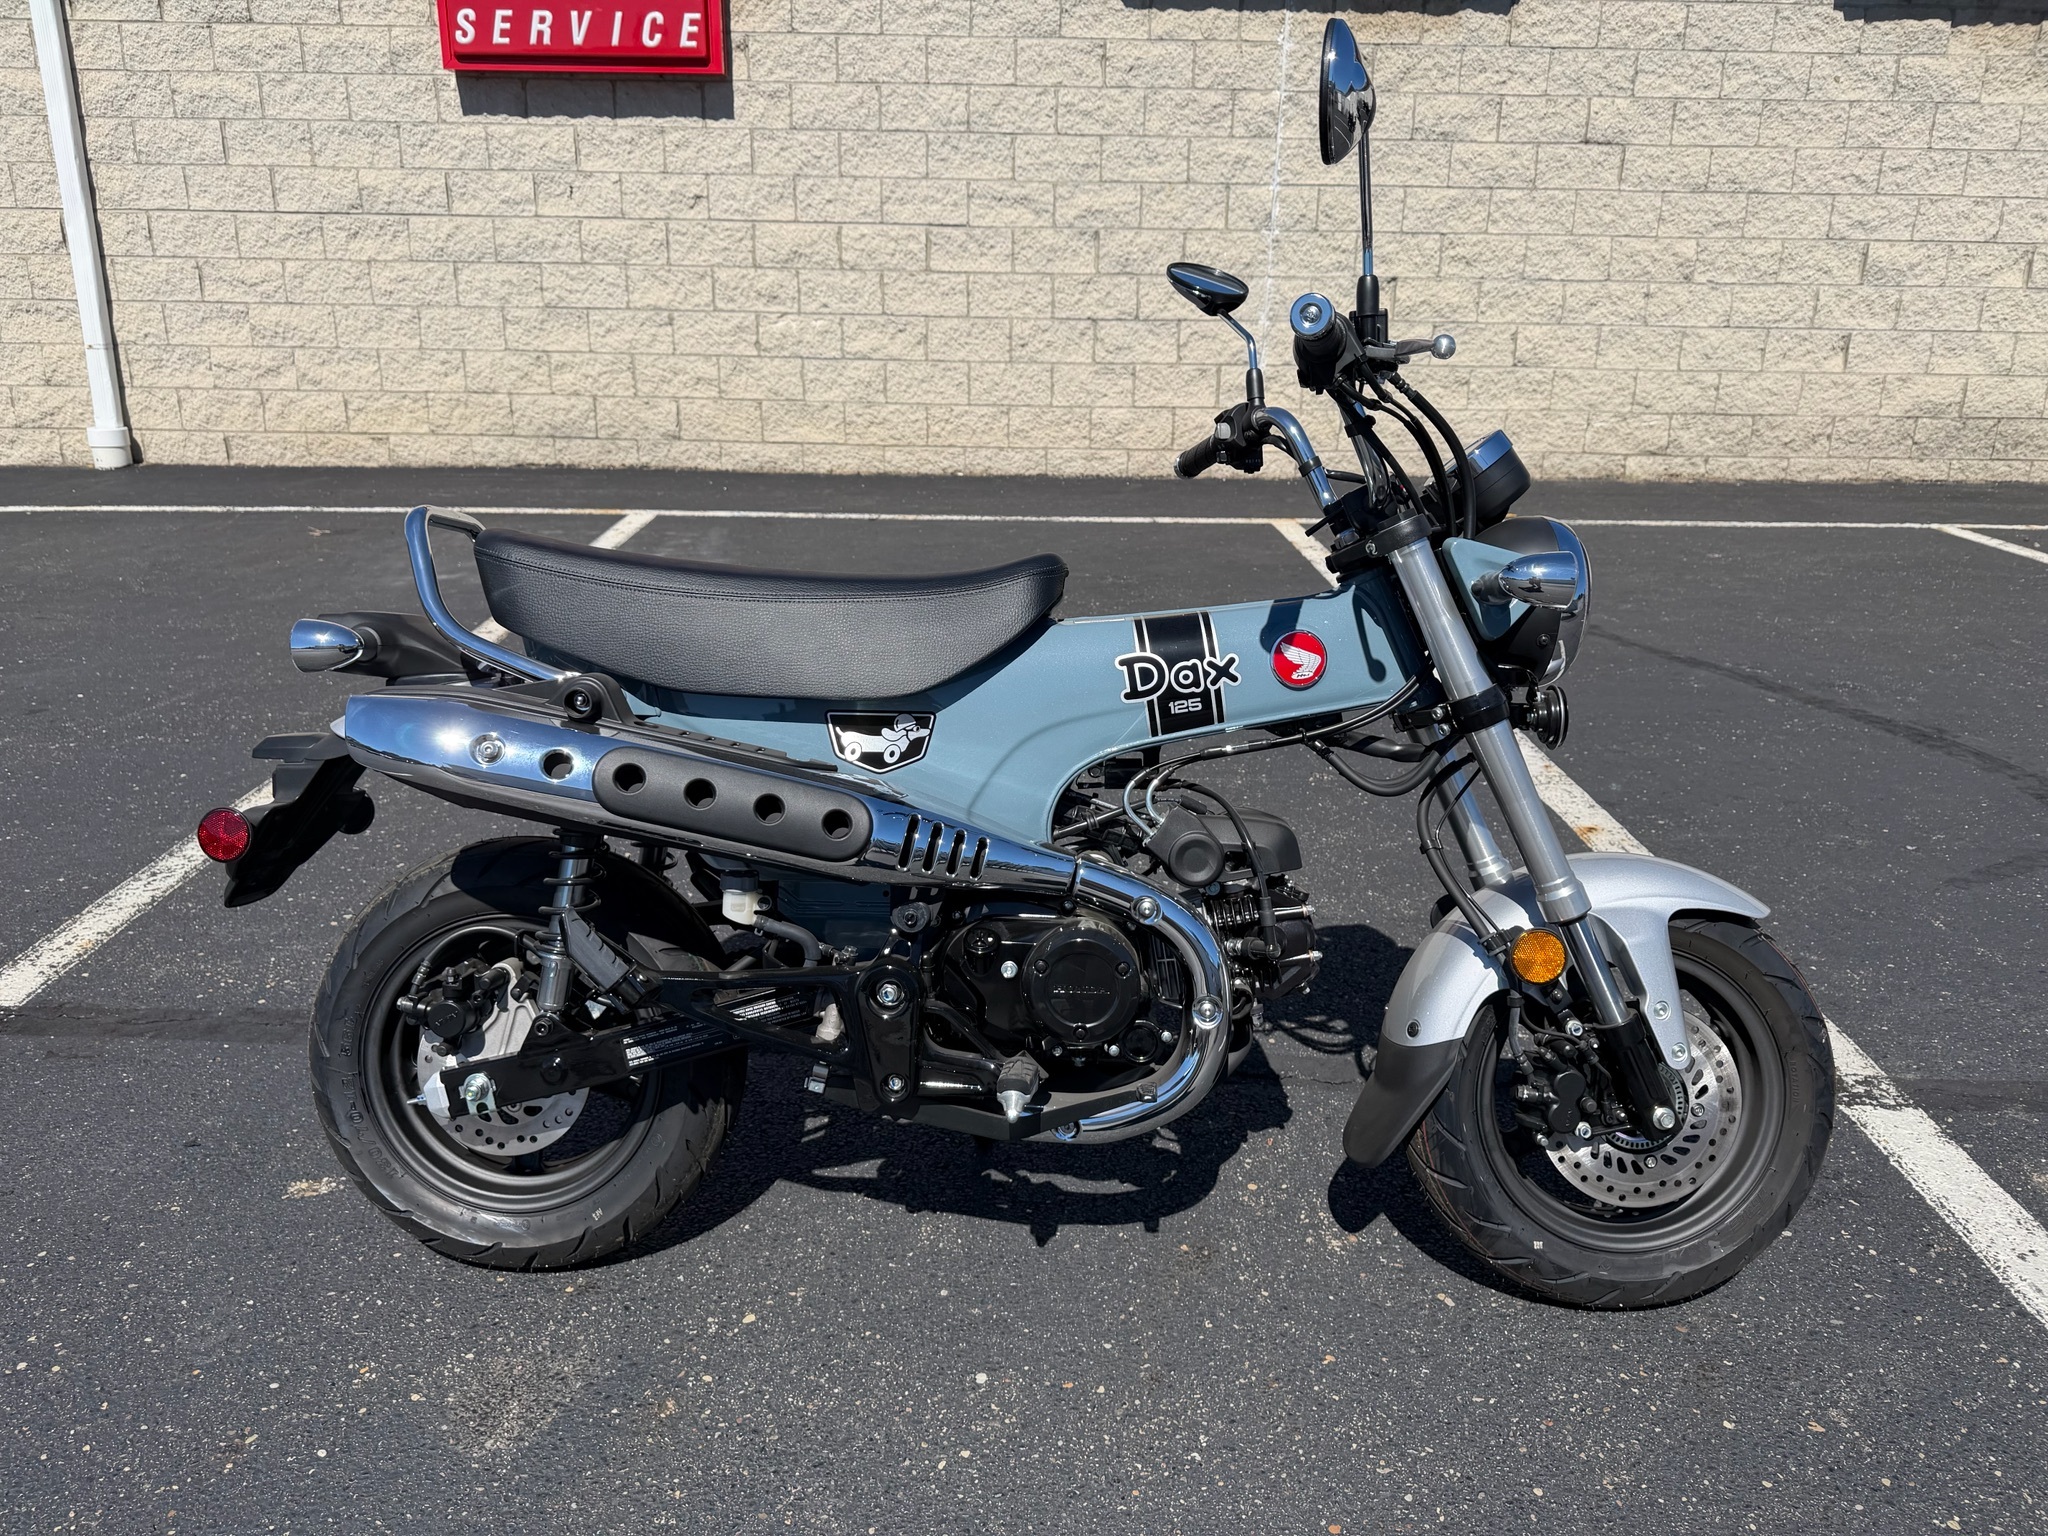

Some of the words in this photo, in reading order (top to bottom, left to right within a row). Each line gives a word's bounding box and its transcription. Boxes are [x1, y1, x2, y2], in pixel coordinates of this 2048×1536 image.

[455, 7, 702, 48] SERVICE
[1115, 652, 1241, 703] Dax
[1169, 698, 1202, 714] 125
